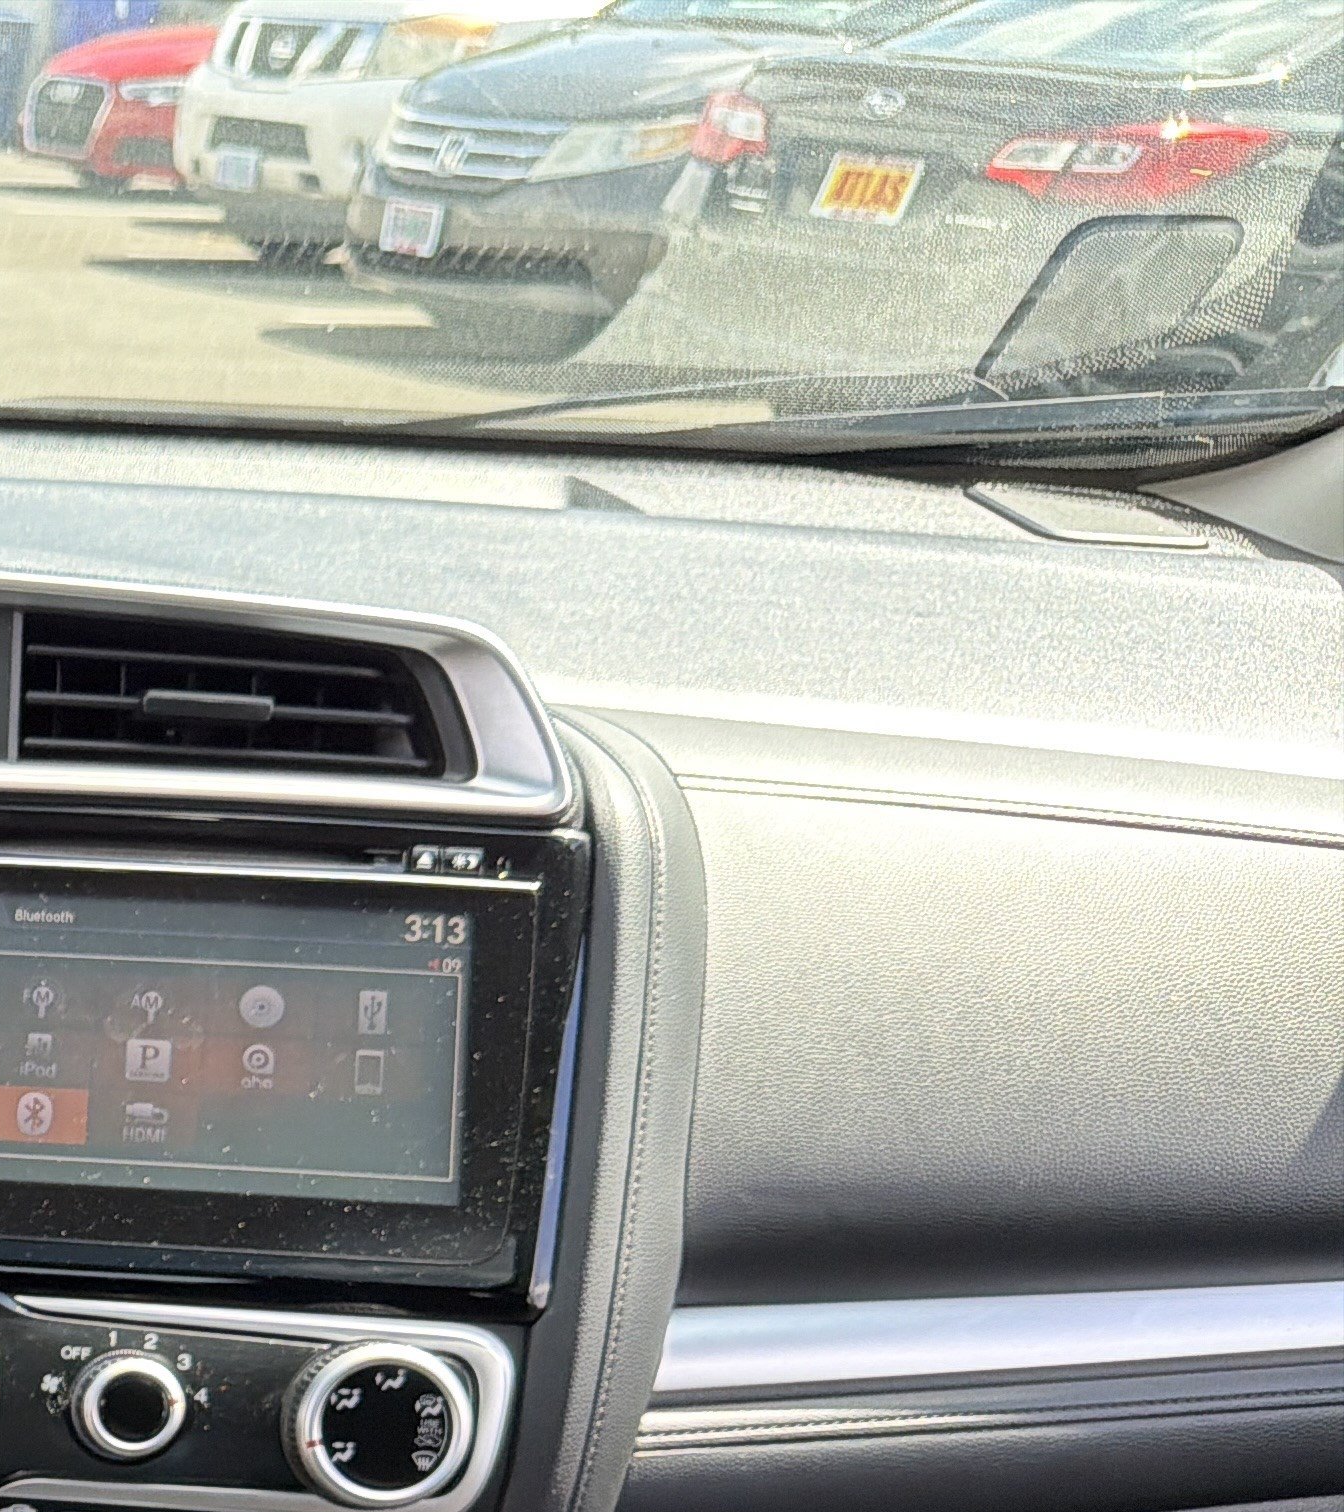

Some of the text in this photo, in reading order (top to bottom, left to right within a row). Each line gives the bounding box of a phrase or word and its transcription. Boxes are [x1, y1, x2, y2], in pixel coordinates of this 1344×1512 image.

[14, 907, 75, 925] Bluetooth
[404, 913, 467, 946] 3:13
[441, 957, 463, 974] 09
[19, 1060, 58, 1080] iPod
[122, 1125, 166, 1144] HDMI
[108, 1330, 118, 1348] 1
[143, 1332, 159, 1351] 2
[60, 1345, 92, 1361] OFF
[176, 1353, 192, 1371] 3
[193, 1386, 209, 1408] 4
